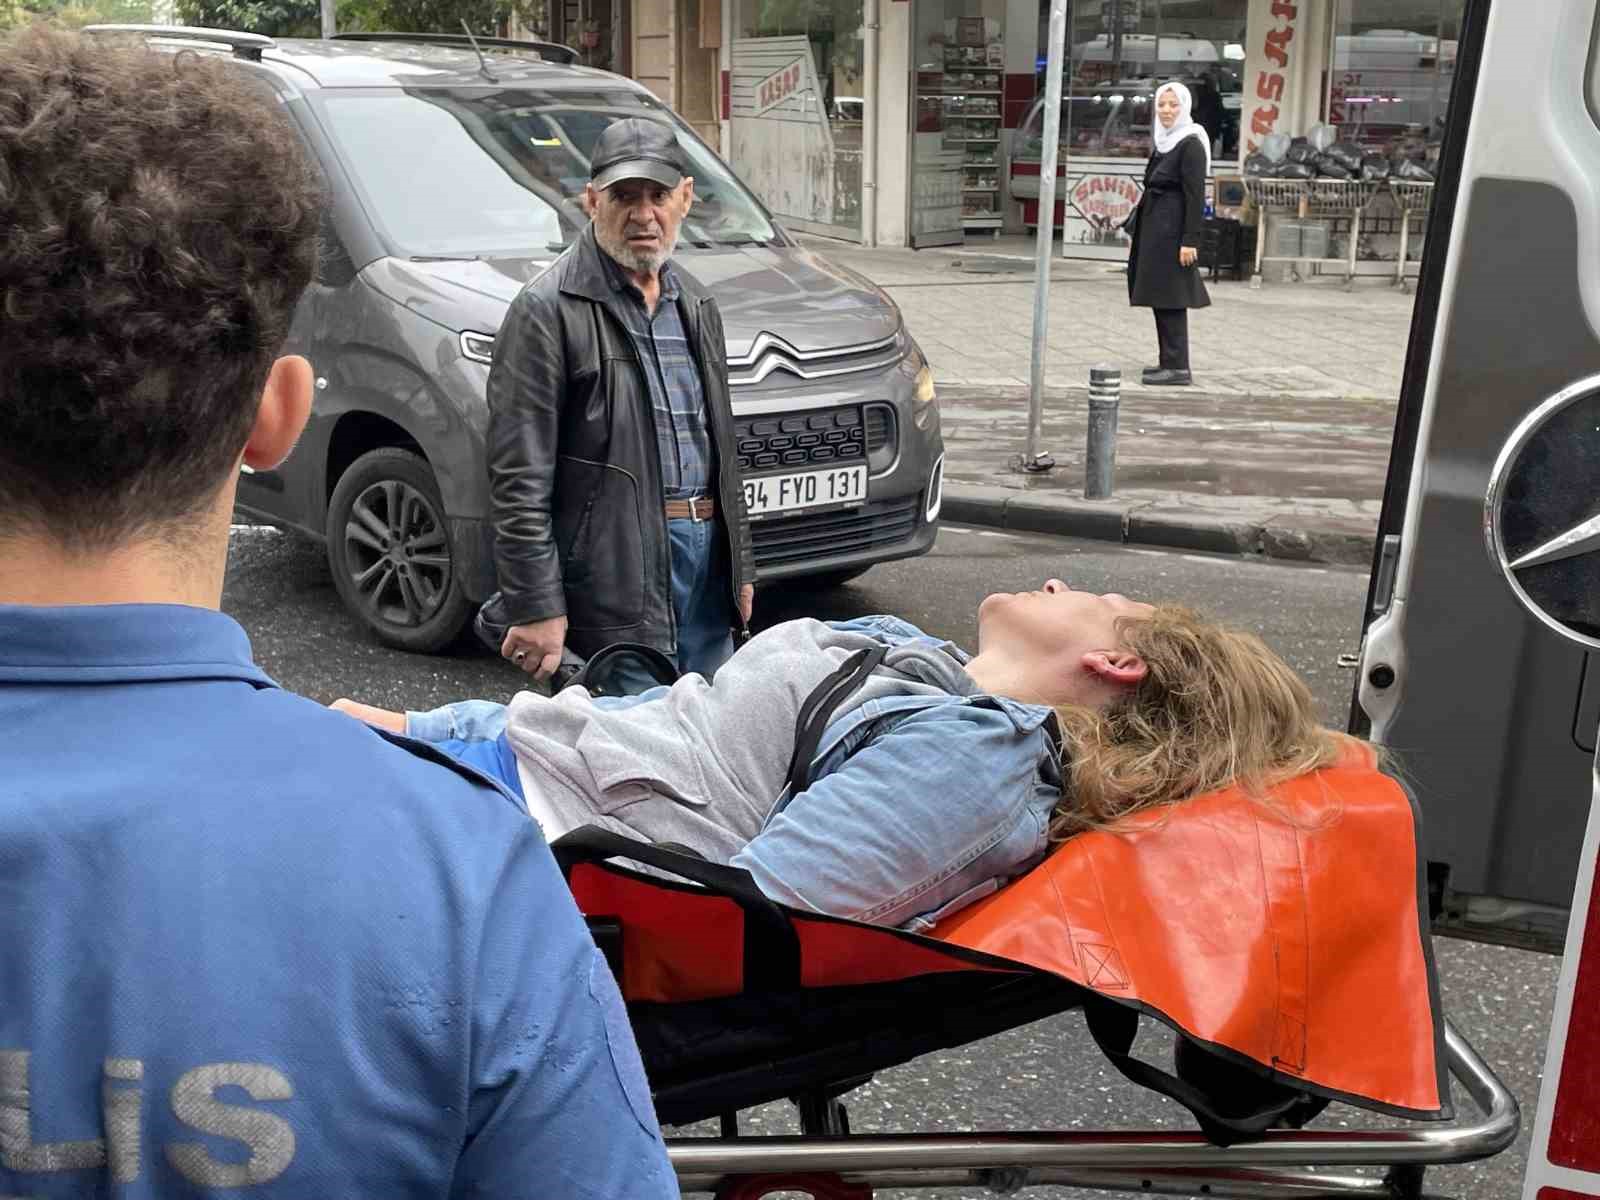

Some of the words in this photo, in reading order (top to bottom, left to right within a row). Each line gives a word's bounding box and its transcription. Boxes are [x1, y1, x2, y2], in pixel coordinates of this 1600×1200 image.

[744, 482, 768, 508] 34
[779, 475, 817, 506] FYD
[828, 469, 860, 499] 131
